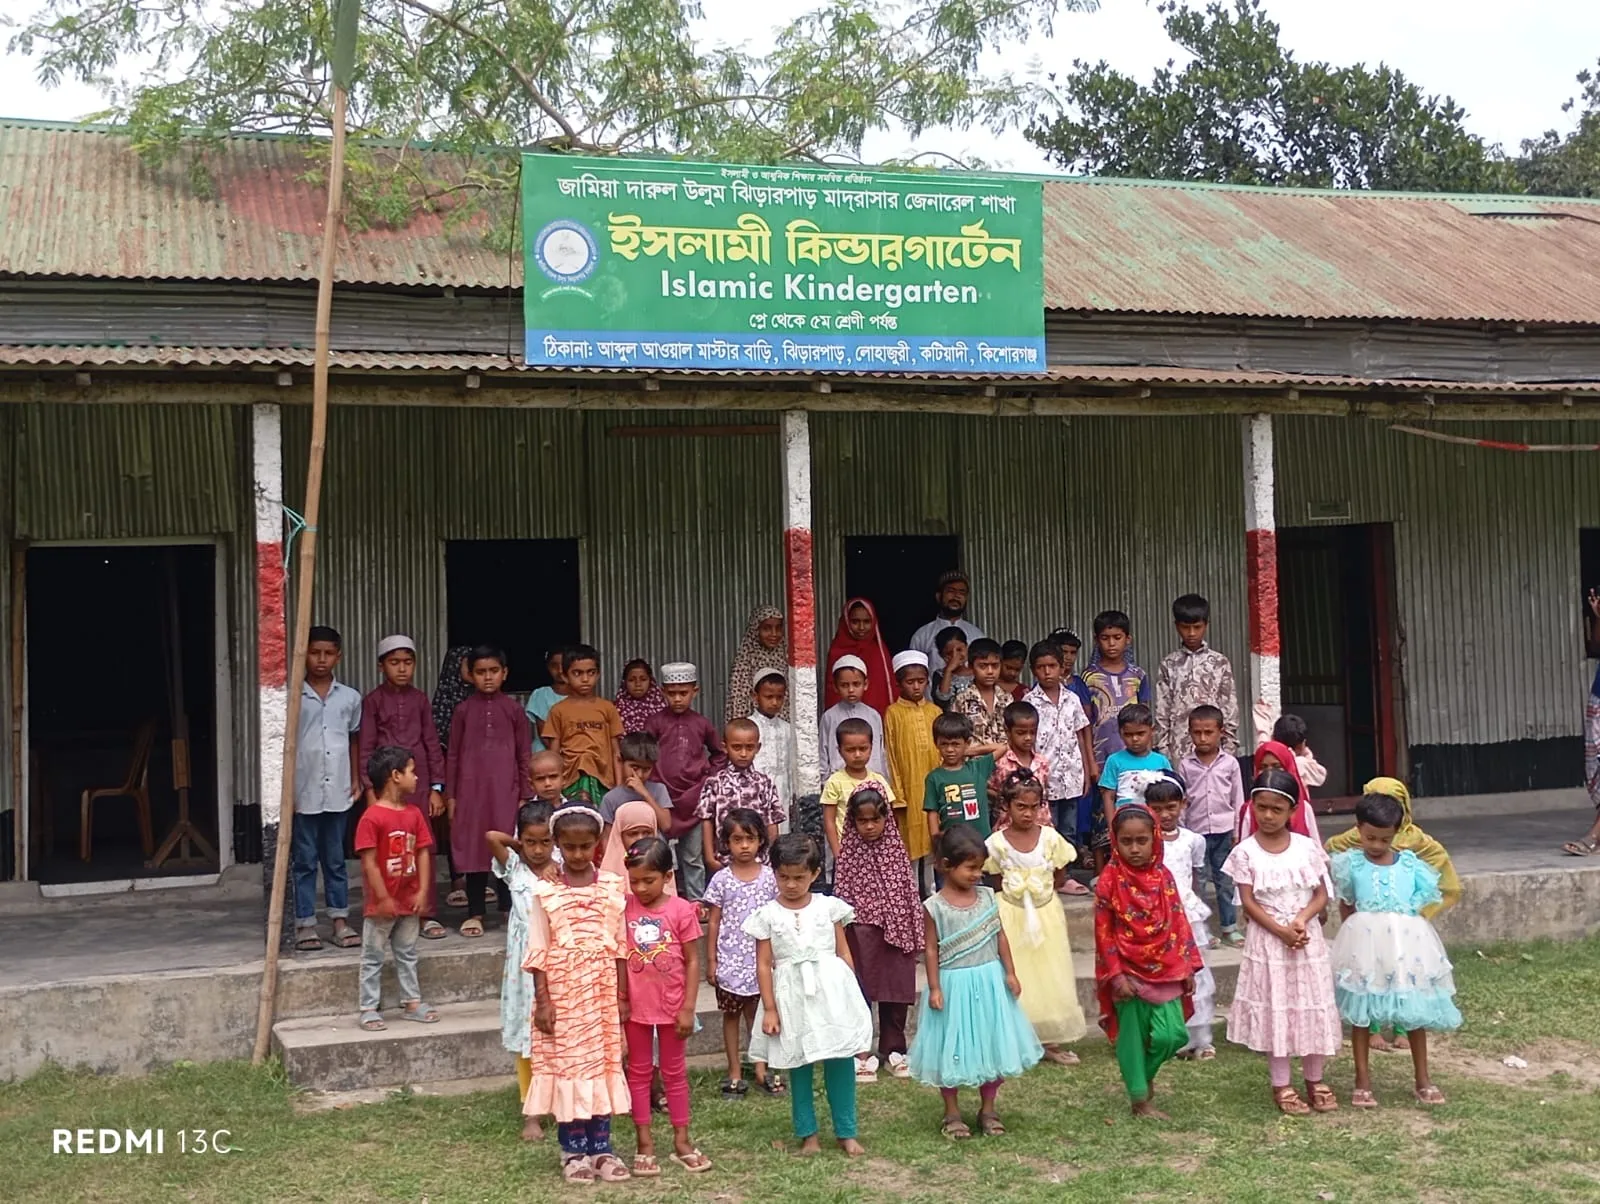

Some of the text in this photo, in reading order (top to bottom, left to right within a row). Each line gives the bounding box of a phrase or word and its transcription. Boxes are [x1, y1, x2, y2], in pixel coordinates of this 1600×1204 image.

[557, 173, 620, 199] জামিয়া
[624, 180, 678, 201] দারুল
[682, 177, 727, 208] উলুম
[731, 180, 819, 210] ঝিড়ারপাড়
[904, 192, 976, 213] জেনারেল
[979, 194, 1017, 215] শাখা
[607, 212, 772, 266] ইসলামী
[785, 218, 1022, 272] কিন্ডারগার্টেন
[661, 270, 978, 308] Islamic Kindergarten
[749, 312, 768, 330] প্লে
[771, 312, 807, 330] থেকে
[835, 310, 865, 330] শ্রেণী
[869, 311, 898, 330] পর্যন্ত
[543, 334, 593, 360] ঠিকানা:
[641, 341, 693, 360] আওয়াল
[696, 338, 740, 361] মাস্টার
[978, 340, 1038, 365] কিশোরগঞ্জ
